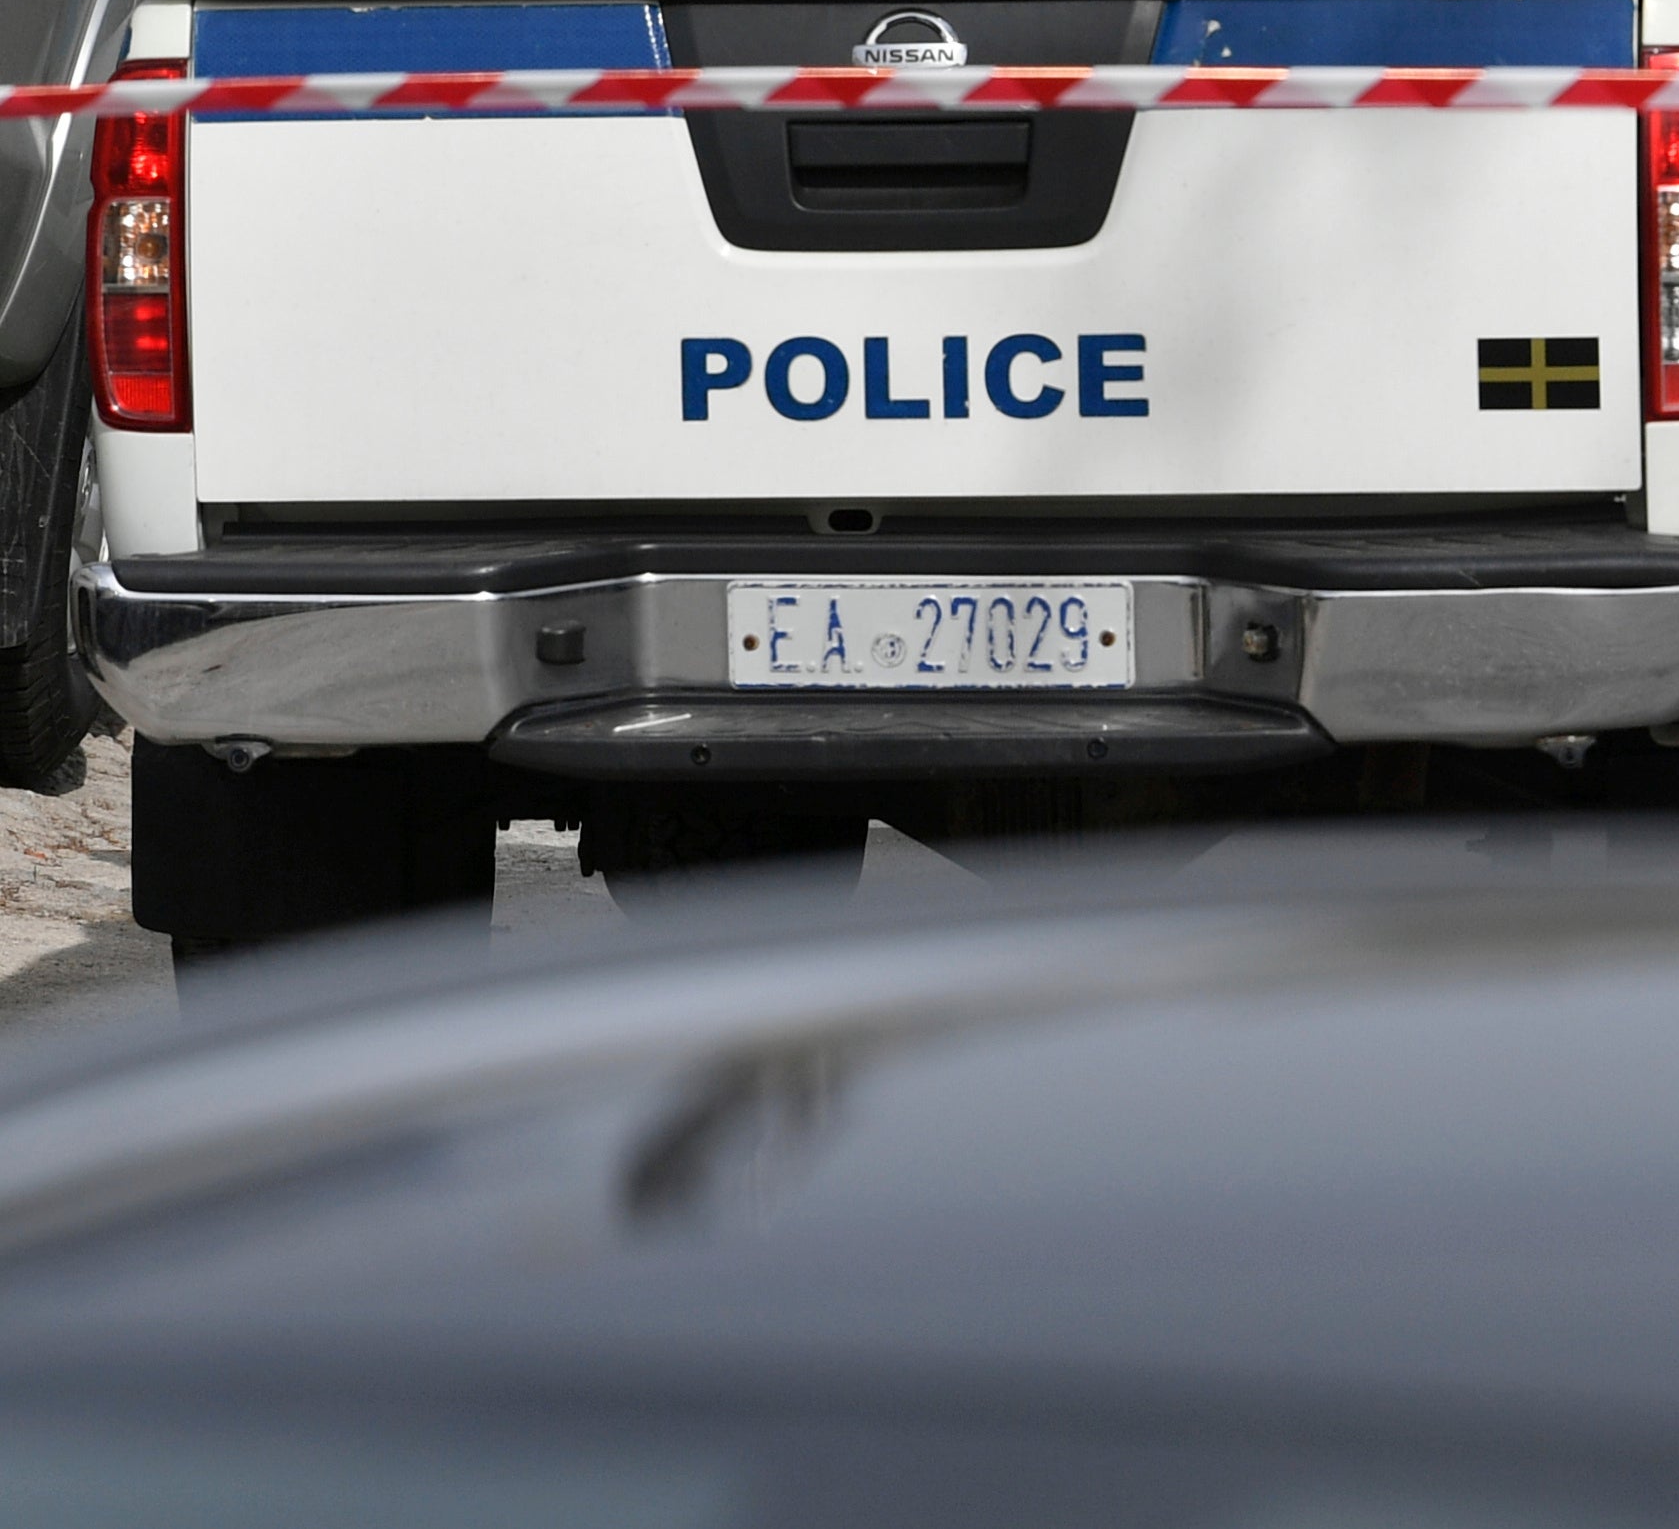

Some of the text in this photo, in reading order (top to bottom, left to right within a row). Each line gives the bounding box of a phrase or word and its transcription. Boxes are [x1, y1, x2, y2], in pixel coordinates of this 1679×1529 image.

[865, 48, 954, 64] NISSAN
[681, 333, 1150, 421] POLICE
[915, 594, 1089, 673] 27029
